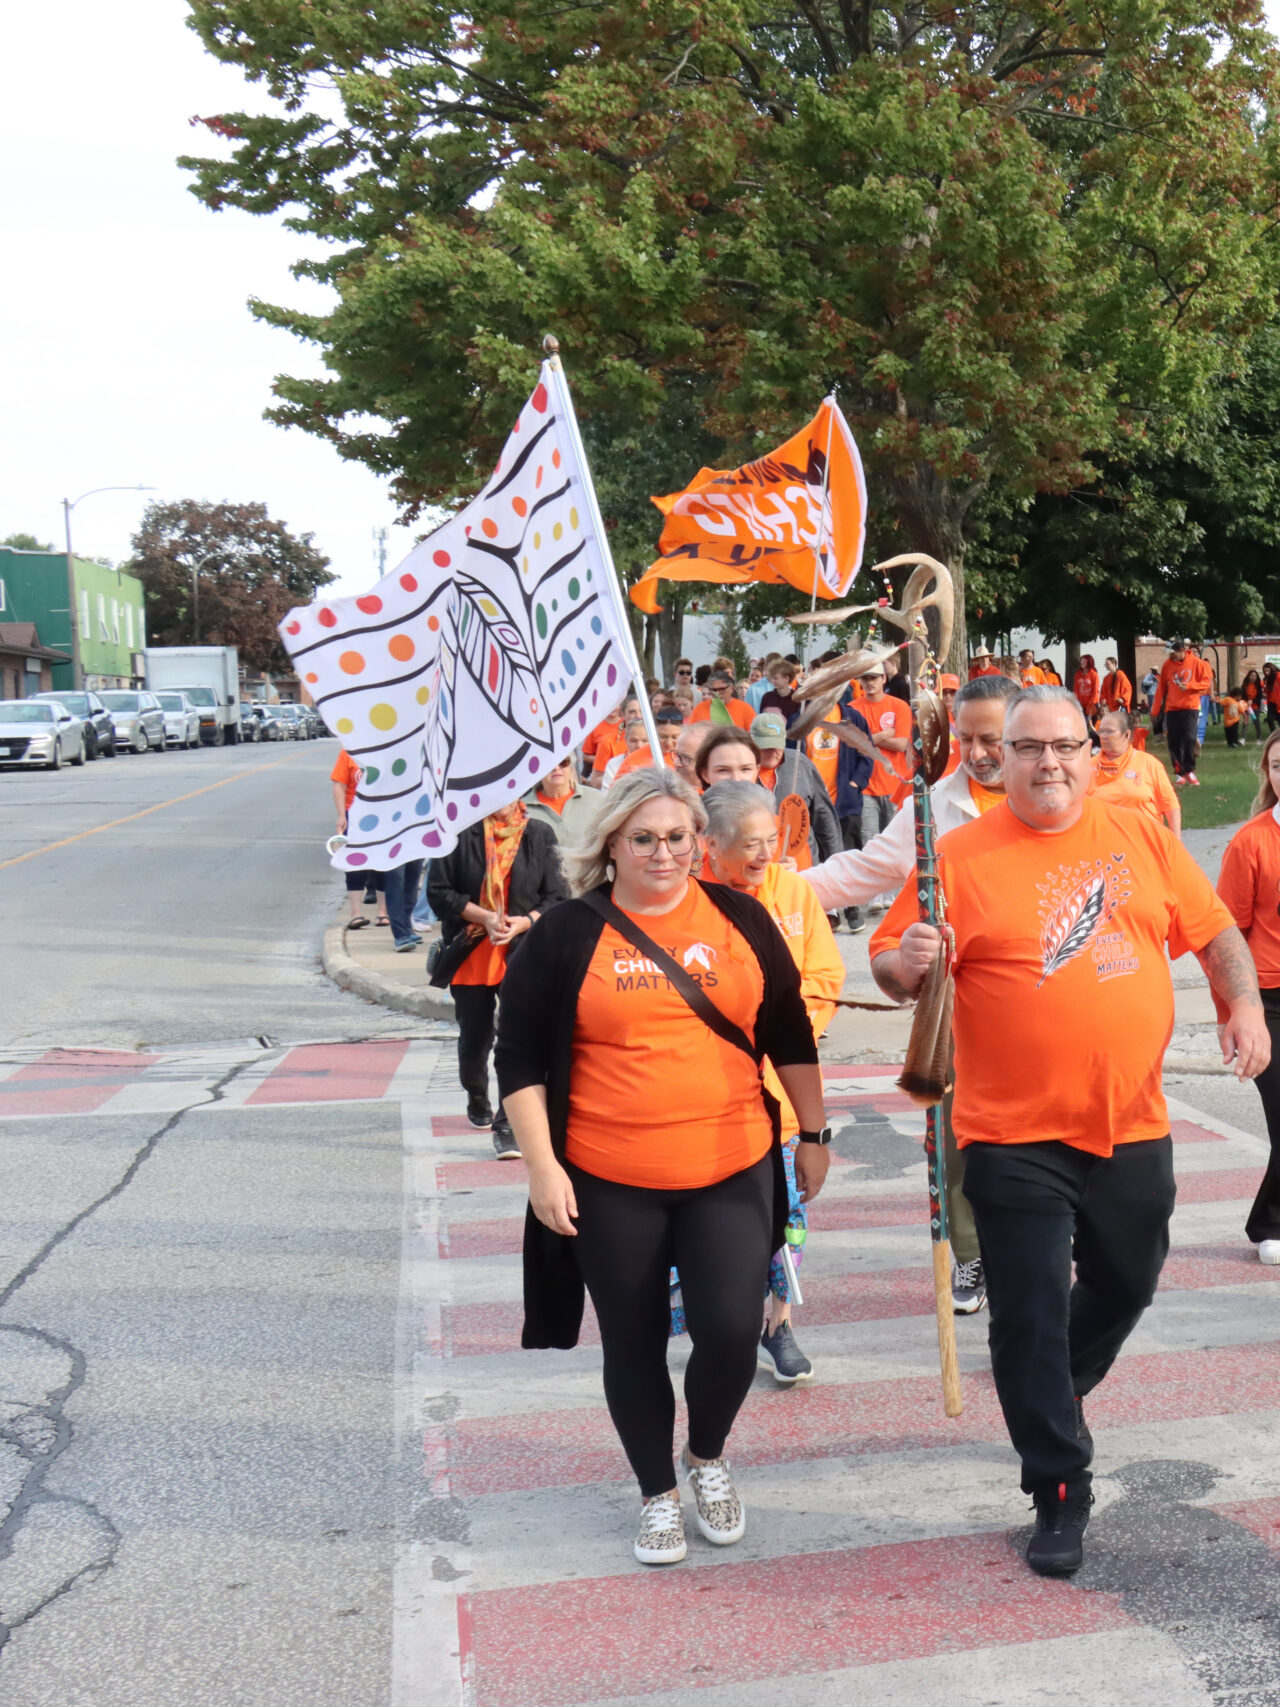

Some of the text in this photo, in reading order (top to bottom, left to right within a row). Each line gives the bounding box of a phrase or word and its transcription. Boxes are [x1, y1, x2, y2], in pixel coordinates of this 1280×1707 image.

[1096, 932, 1124, 946] EVERY
[613, 946, 677, 959] EVY
[613, 959, 666, 973] CHIL
[1097, 957, 1139, 976] MATTERS
[616, 971, 718, 992] MATTRS
